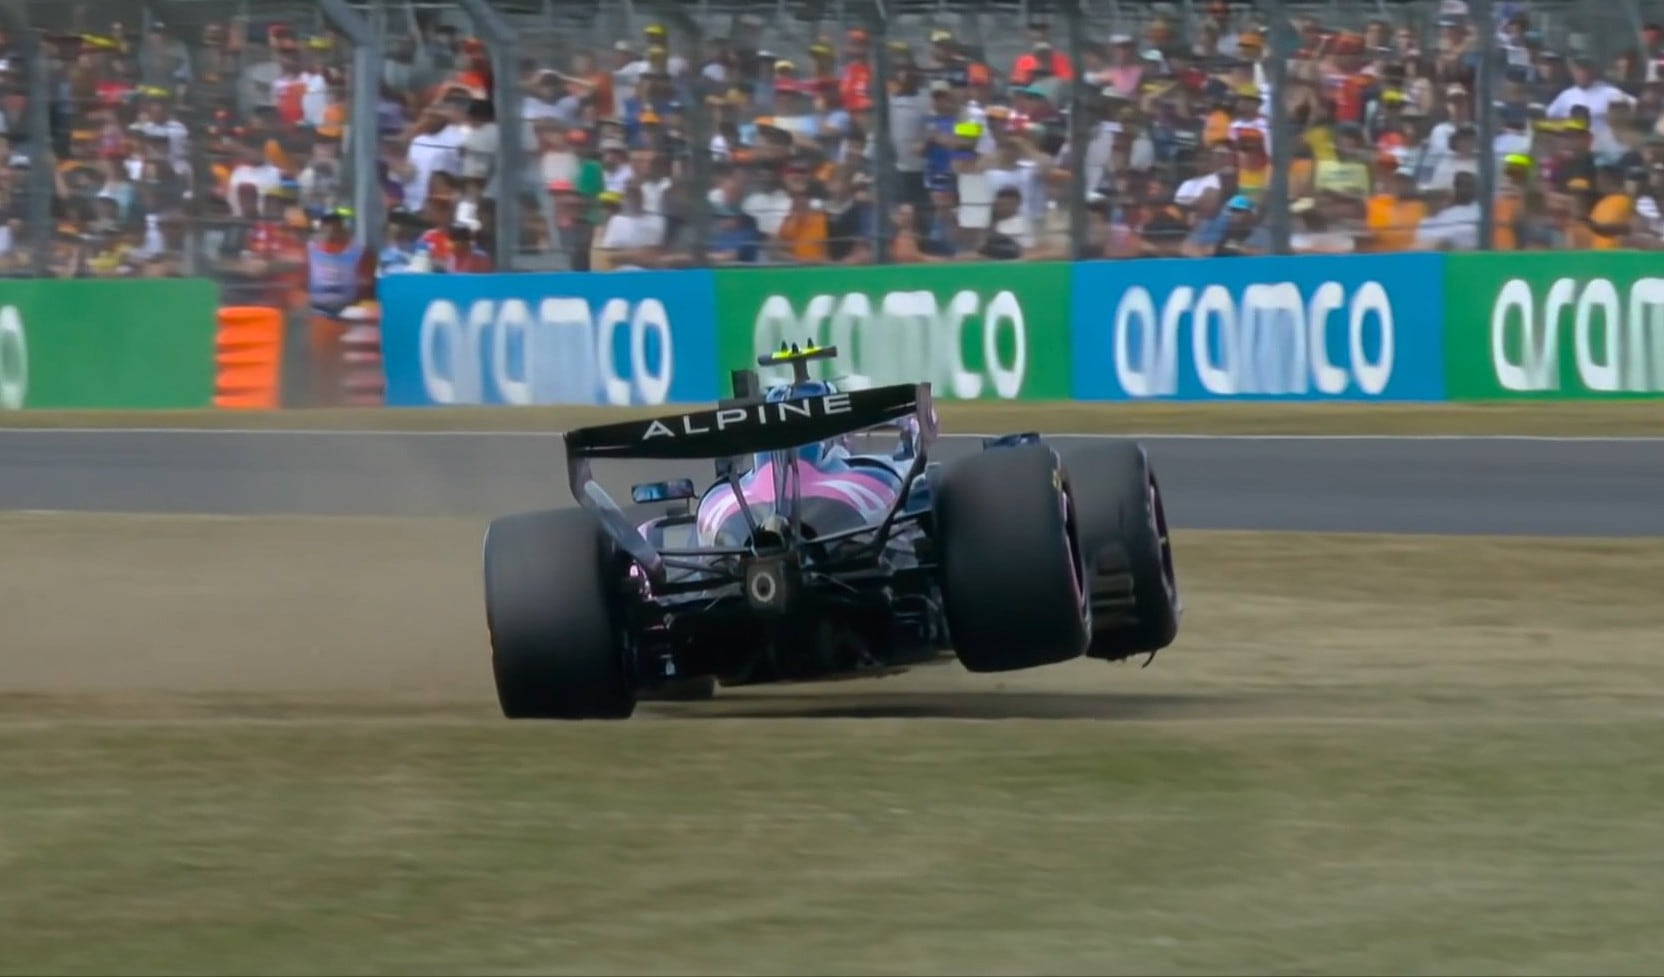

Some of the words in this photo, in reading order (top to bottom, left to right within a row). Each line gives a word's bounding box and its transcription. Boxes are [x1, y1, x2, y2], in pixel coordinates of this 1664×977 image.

[419, 298, 673, 405] aramco
[754, 290, 1026, 399] aramco
[1114, 281, 1394, 395] aramco
[642, 394, 852, 440] ALPINE
